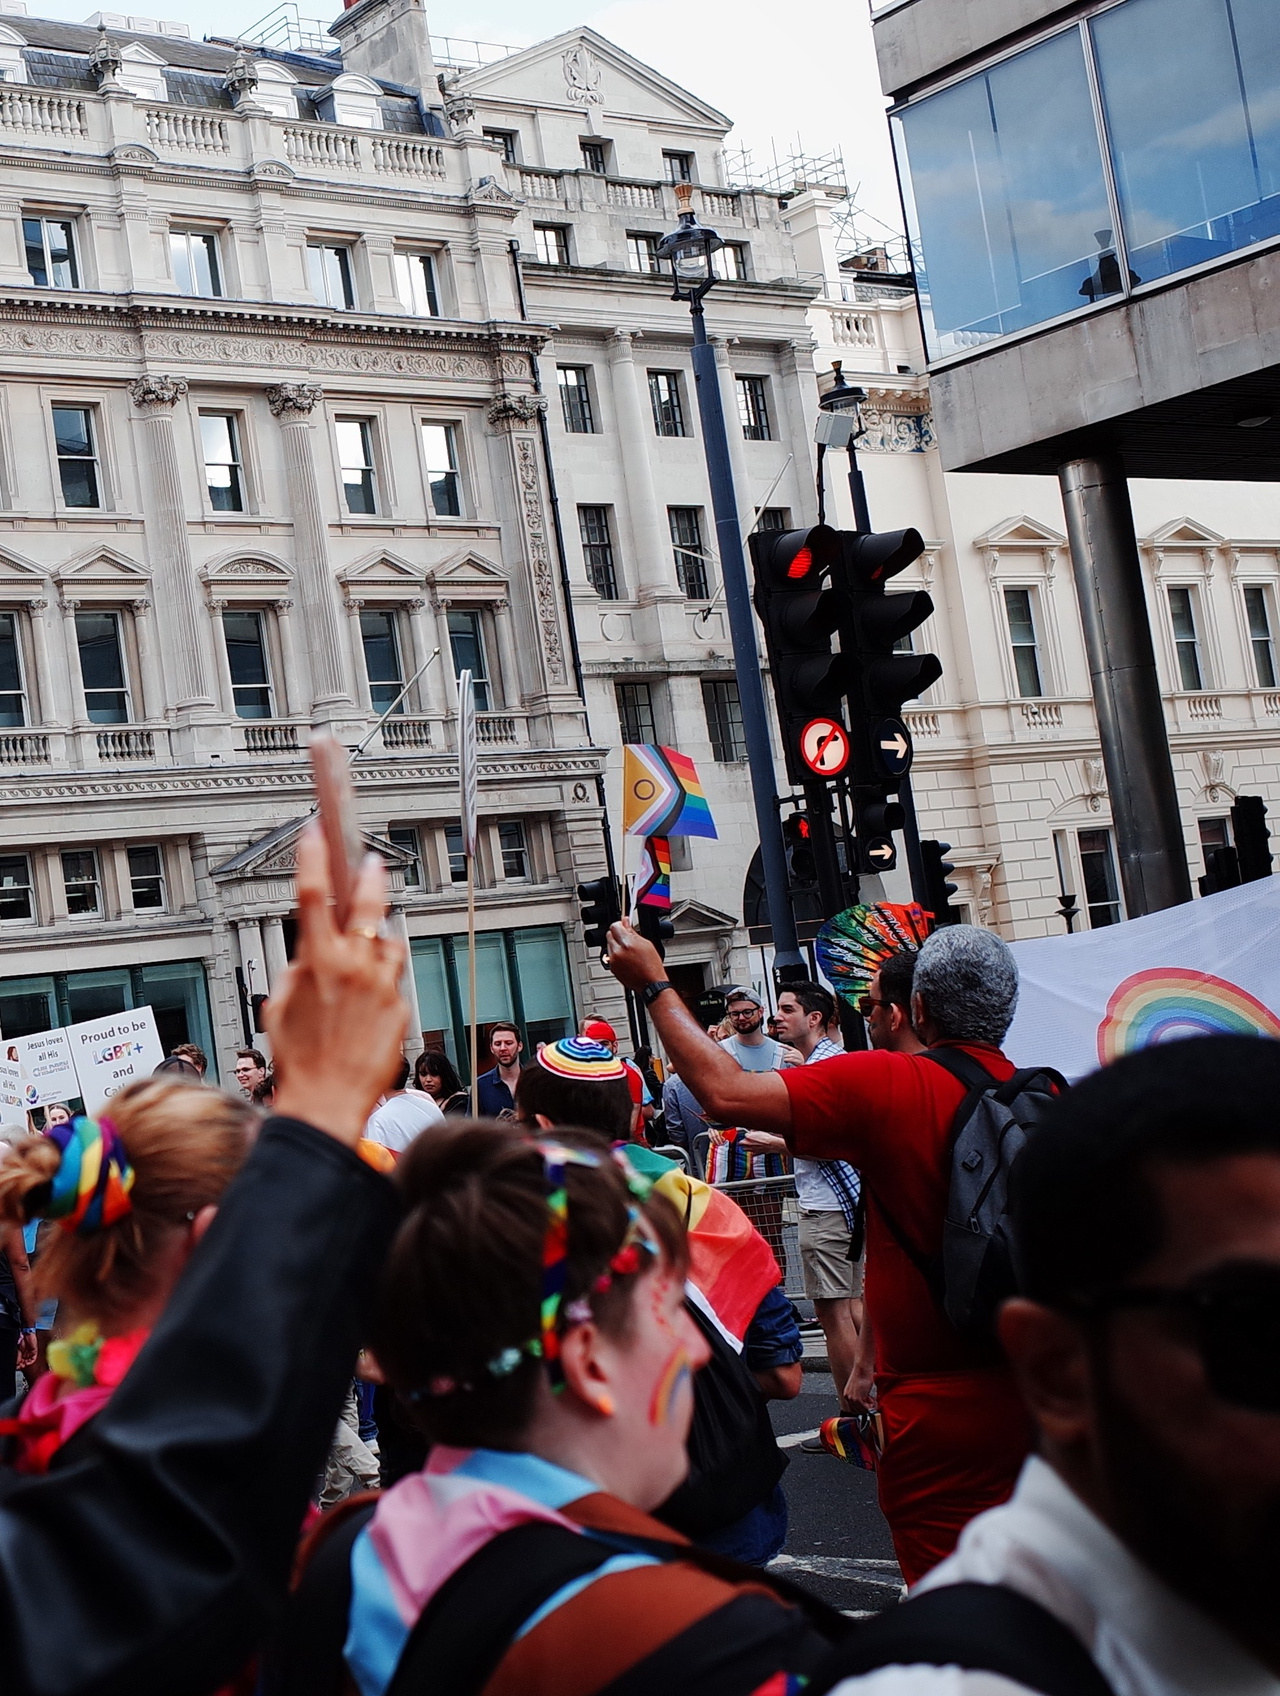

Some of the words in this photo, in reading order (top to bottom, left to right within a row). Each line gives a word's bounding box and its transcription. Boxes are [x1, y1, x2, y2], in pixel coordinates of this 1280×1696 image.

[81, 1027, 115, 1045] Proud
[118, 1026, 130, 1035] to
[131, 1021, 147, 1032] be
[27, 1040, 45, 1050] Jesus
[45, 1036, 63, 1047] loves
[38, 1053, 47, 1062] all
[48, 1050, 59, 1060] His
[92, 1041, 144, 1065] LGBT+
[112, 1064, 134, 1079] and
